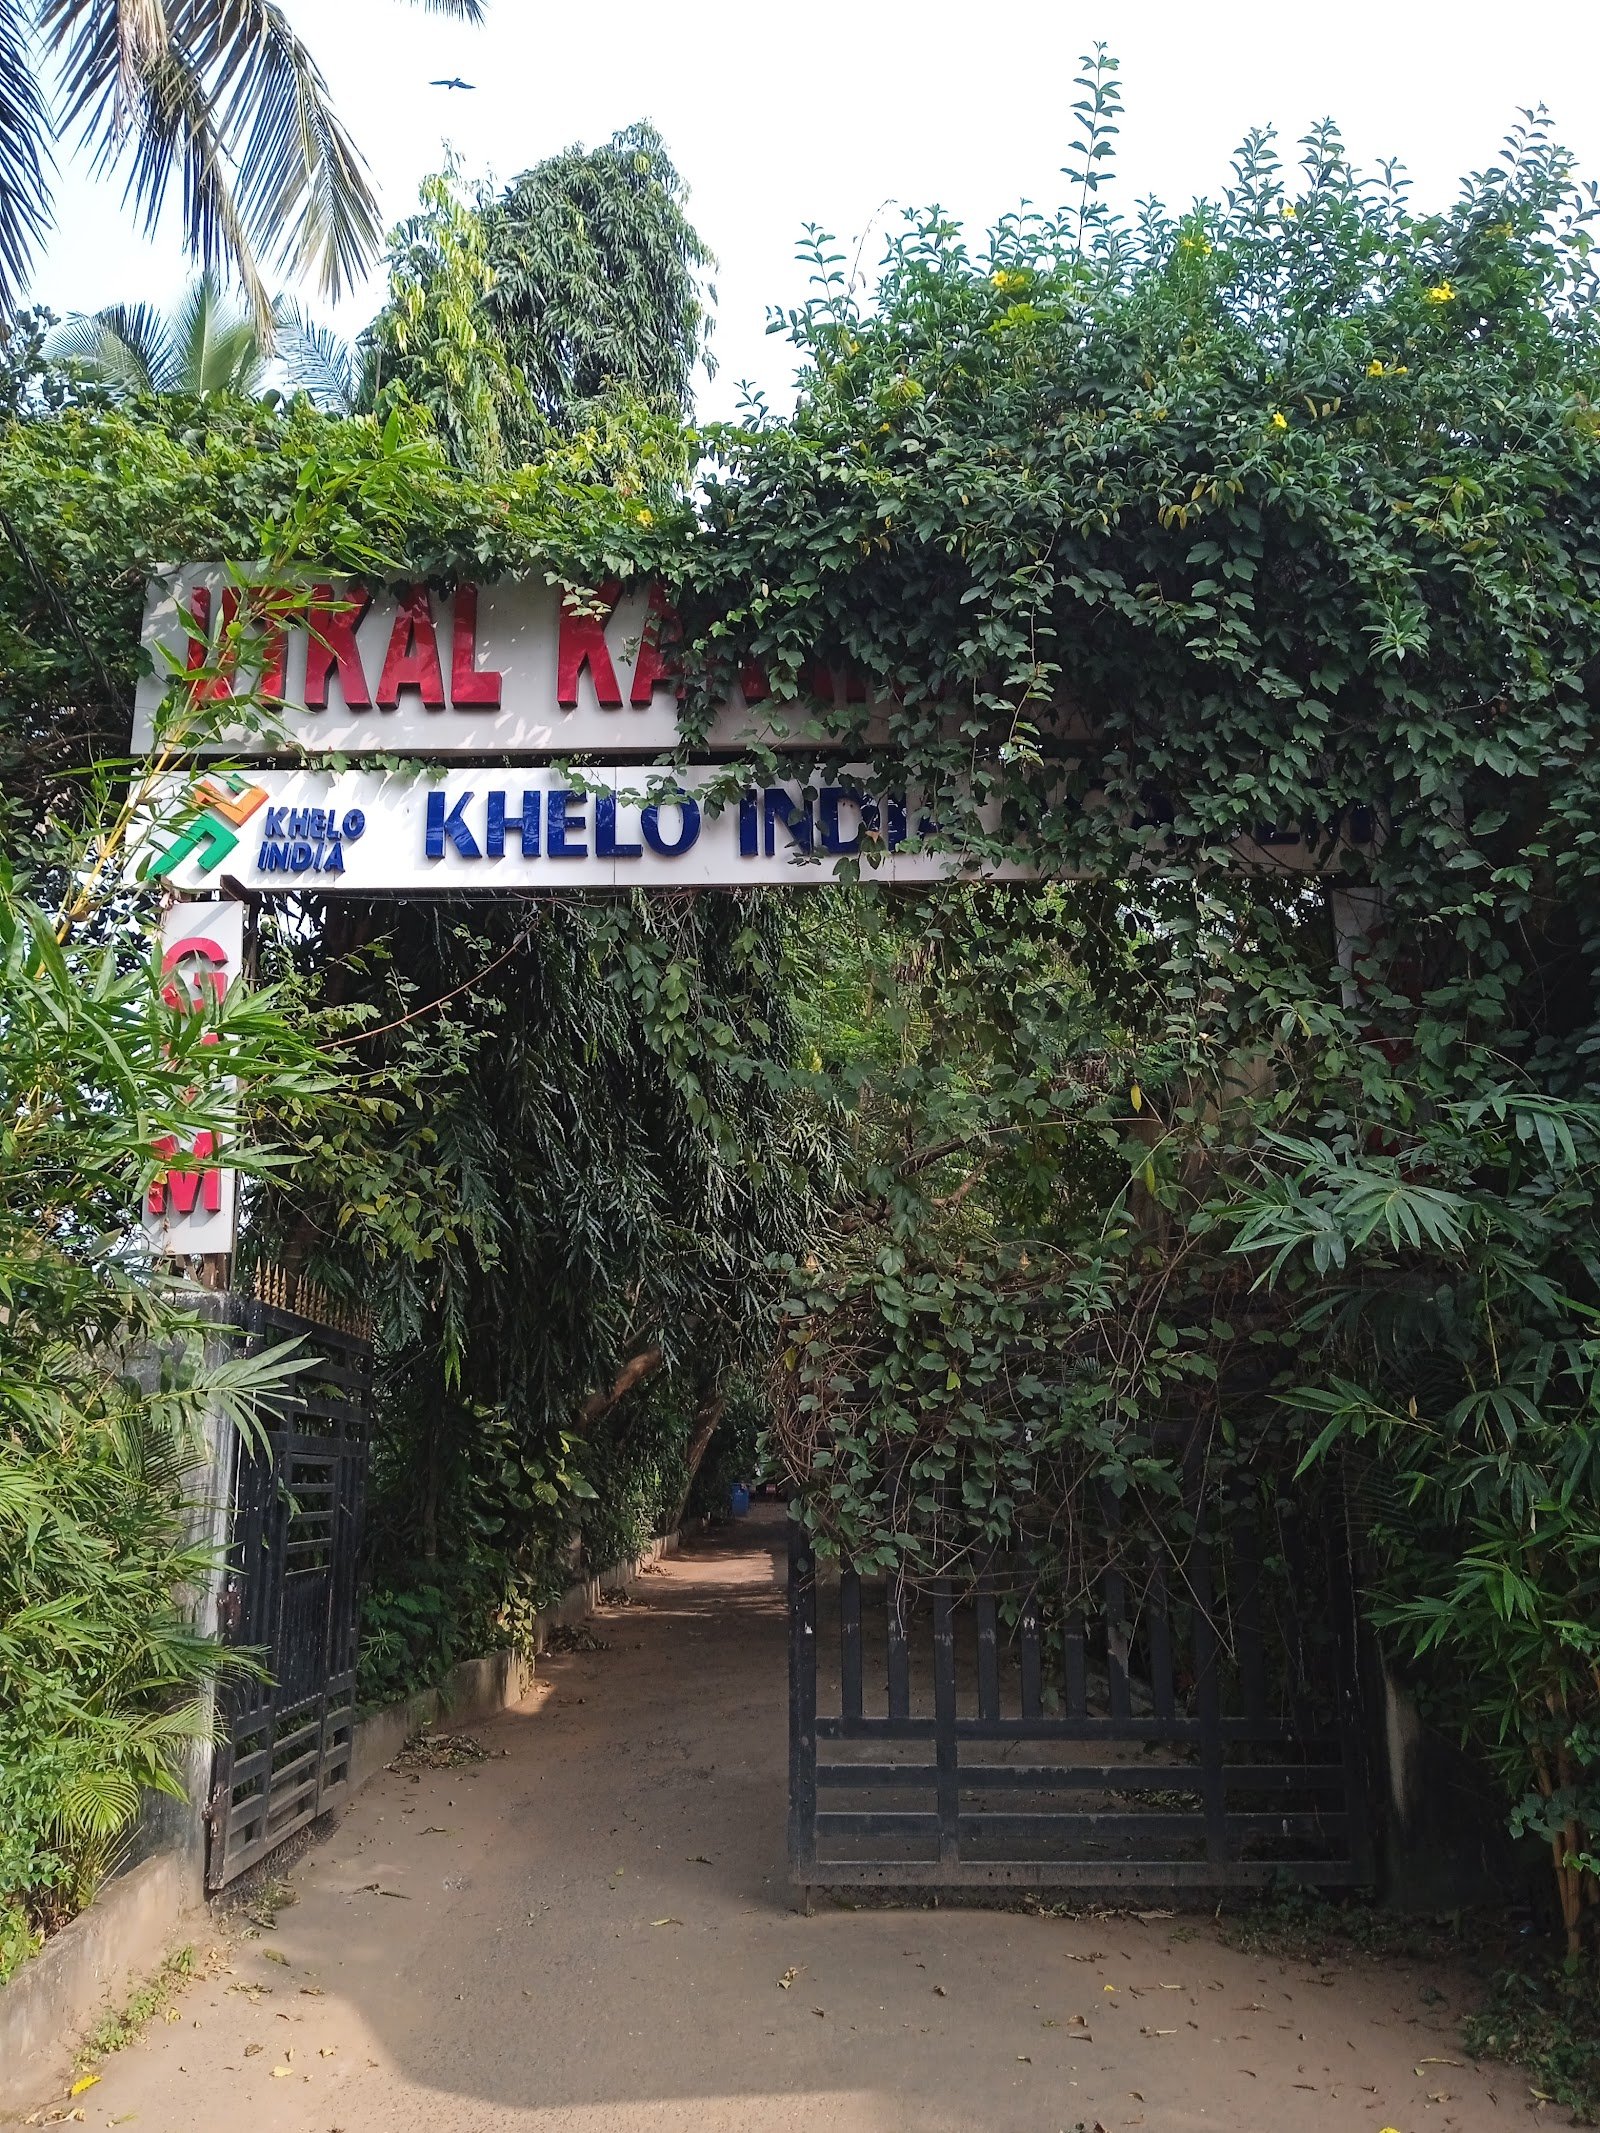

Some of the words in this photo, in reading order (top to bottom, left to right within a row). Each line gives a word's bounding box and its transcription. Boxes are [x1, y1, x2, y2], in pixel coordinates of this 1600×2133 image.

[264, 806, 366, 841] KHELO
[425, 789, 702, 859] KHELO
[739, 786, 946, 857] INDI
[257, 840, 346, 873] INDIA
[148, 936, 229, 1214] GM
